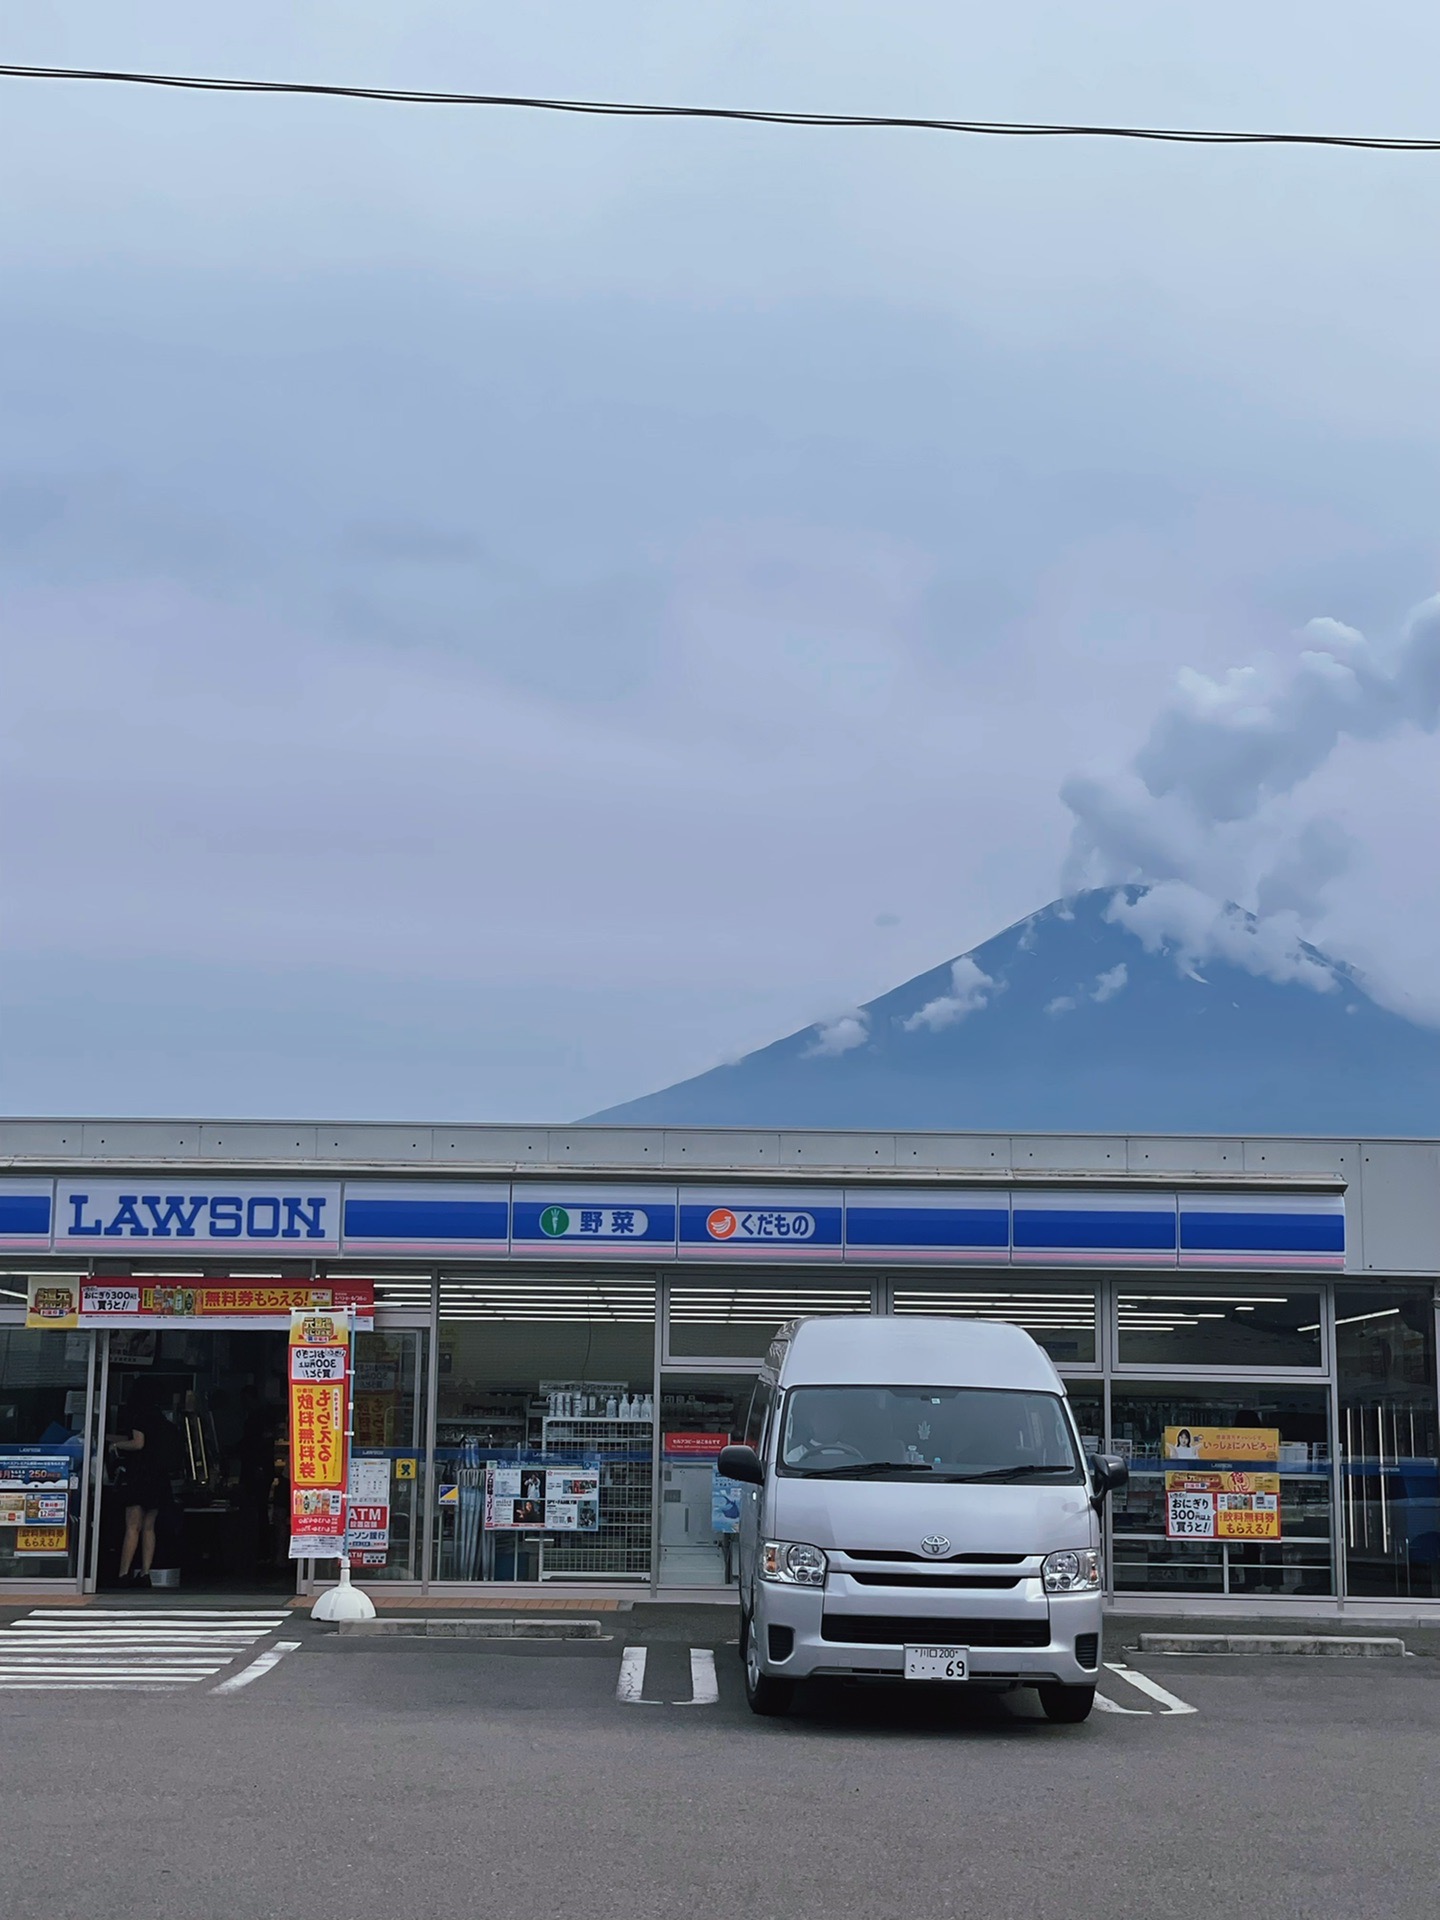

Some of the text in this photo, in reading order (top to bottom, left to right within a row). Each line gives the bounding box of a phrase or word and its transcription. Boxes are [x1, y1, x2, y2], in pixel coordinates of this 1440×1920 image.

[68, 1195, 326, 1238] LAWSON
[579, 1211, 635, 1233] 野菜
[740, 1213, 809, 1236] くだもの
[28, 1470, 47, 1478] 250
[1172, 1499, 1209, 1510] おにぎり
[350, 1508, 381, 1520] ATM
[1171, 1510, 1212, 1521] 300円以上
[1223, 1512, 1275, 1523] 飲料無料券
[1176, 1522, 1208, 1533] 買うと!
[1226, 1523, 1270, 1535] もらえる!
[348, 1532, 386, 1540] ーソン銀行
[24, 1538, 60, 1547] もらえる!
[920, 1649, 955, 1658] 川口 200
[946, 1661, 965, 1677] 69
